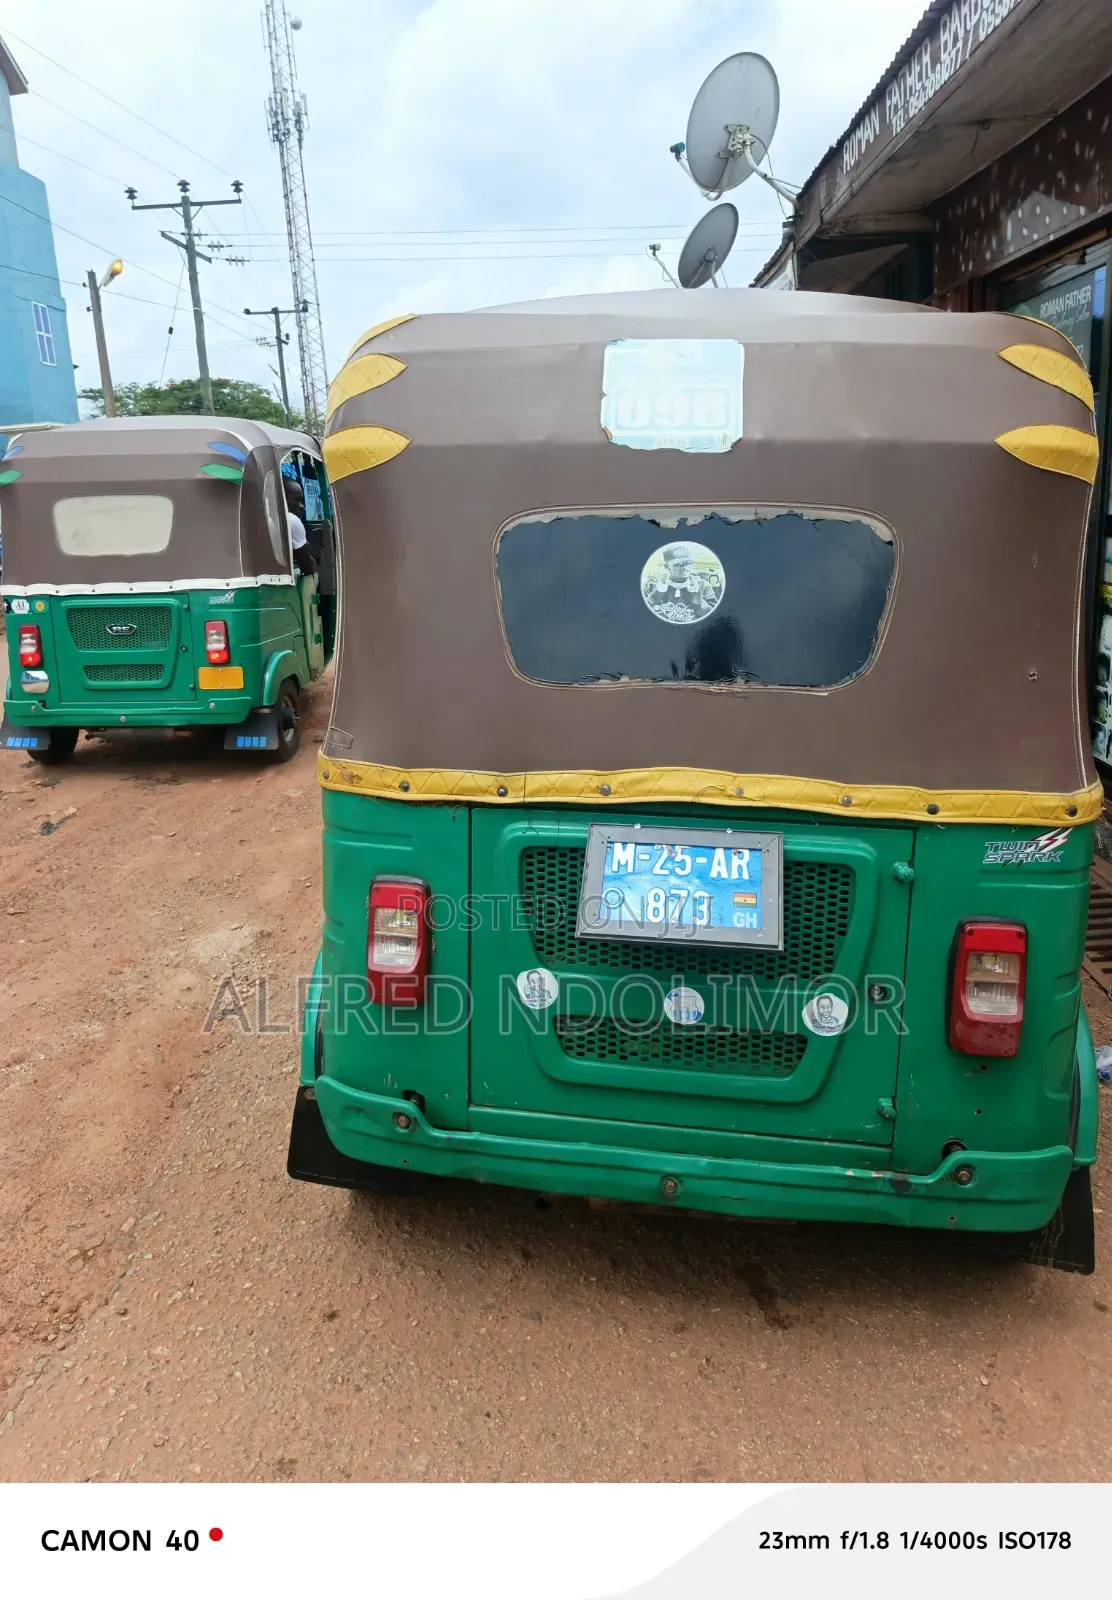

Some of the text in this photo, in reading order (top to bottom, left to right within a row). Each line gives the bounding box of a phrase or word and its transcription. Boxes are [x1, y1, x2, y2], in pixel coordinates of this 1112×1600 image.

[843, 101, 880, 175] ROMAN
[885, 37, 932, 124] FATHER
[1040, 285, 1092, 319] ROMAN FATHER
[616, 389, 729, 429] 098
[611, 843, 750, 880] M-25-AR
[983, 851, 1064, 864] SPARK
[985, 841, 1040, 853] TWIN
[732, 911, 758, 929] GH
